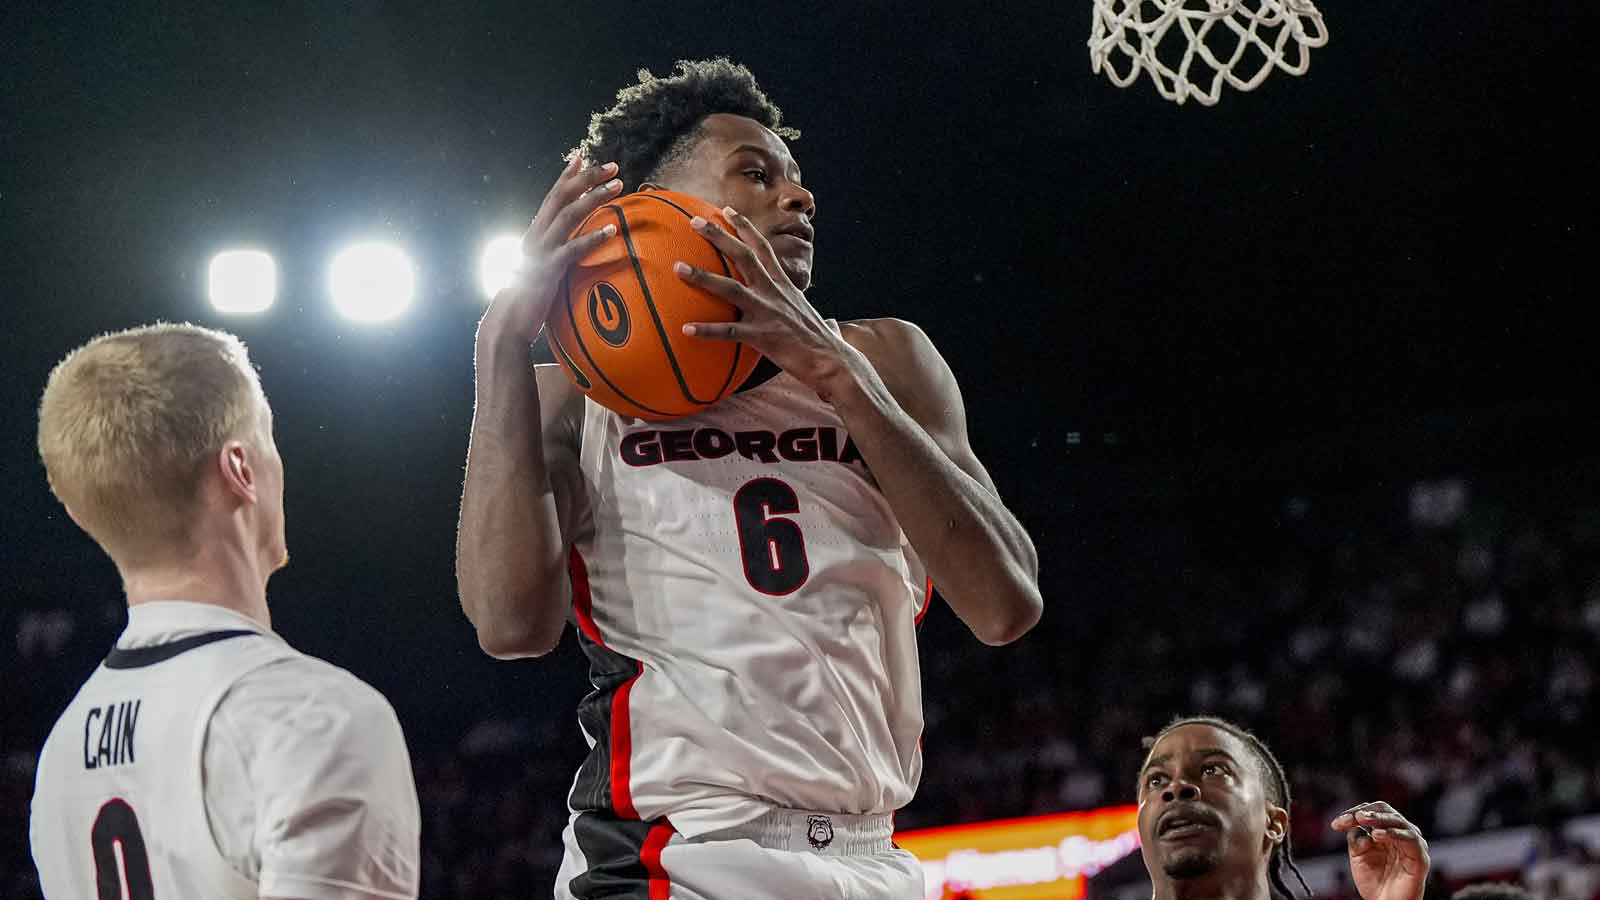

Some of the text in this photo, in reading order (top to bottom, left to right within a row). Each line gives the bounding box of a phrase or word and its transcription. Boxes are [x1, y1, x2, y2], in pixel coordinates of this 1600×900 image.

[588, 282, 631, 347] G
[733, 477, 810, 597] 6
[84, 699, 141, 769] CAIN
